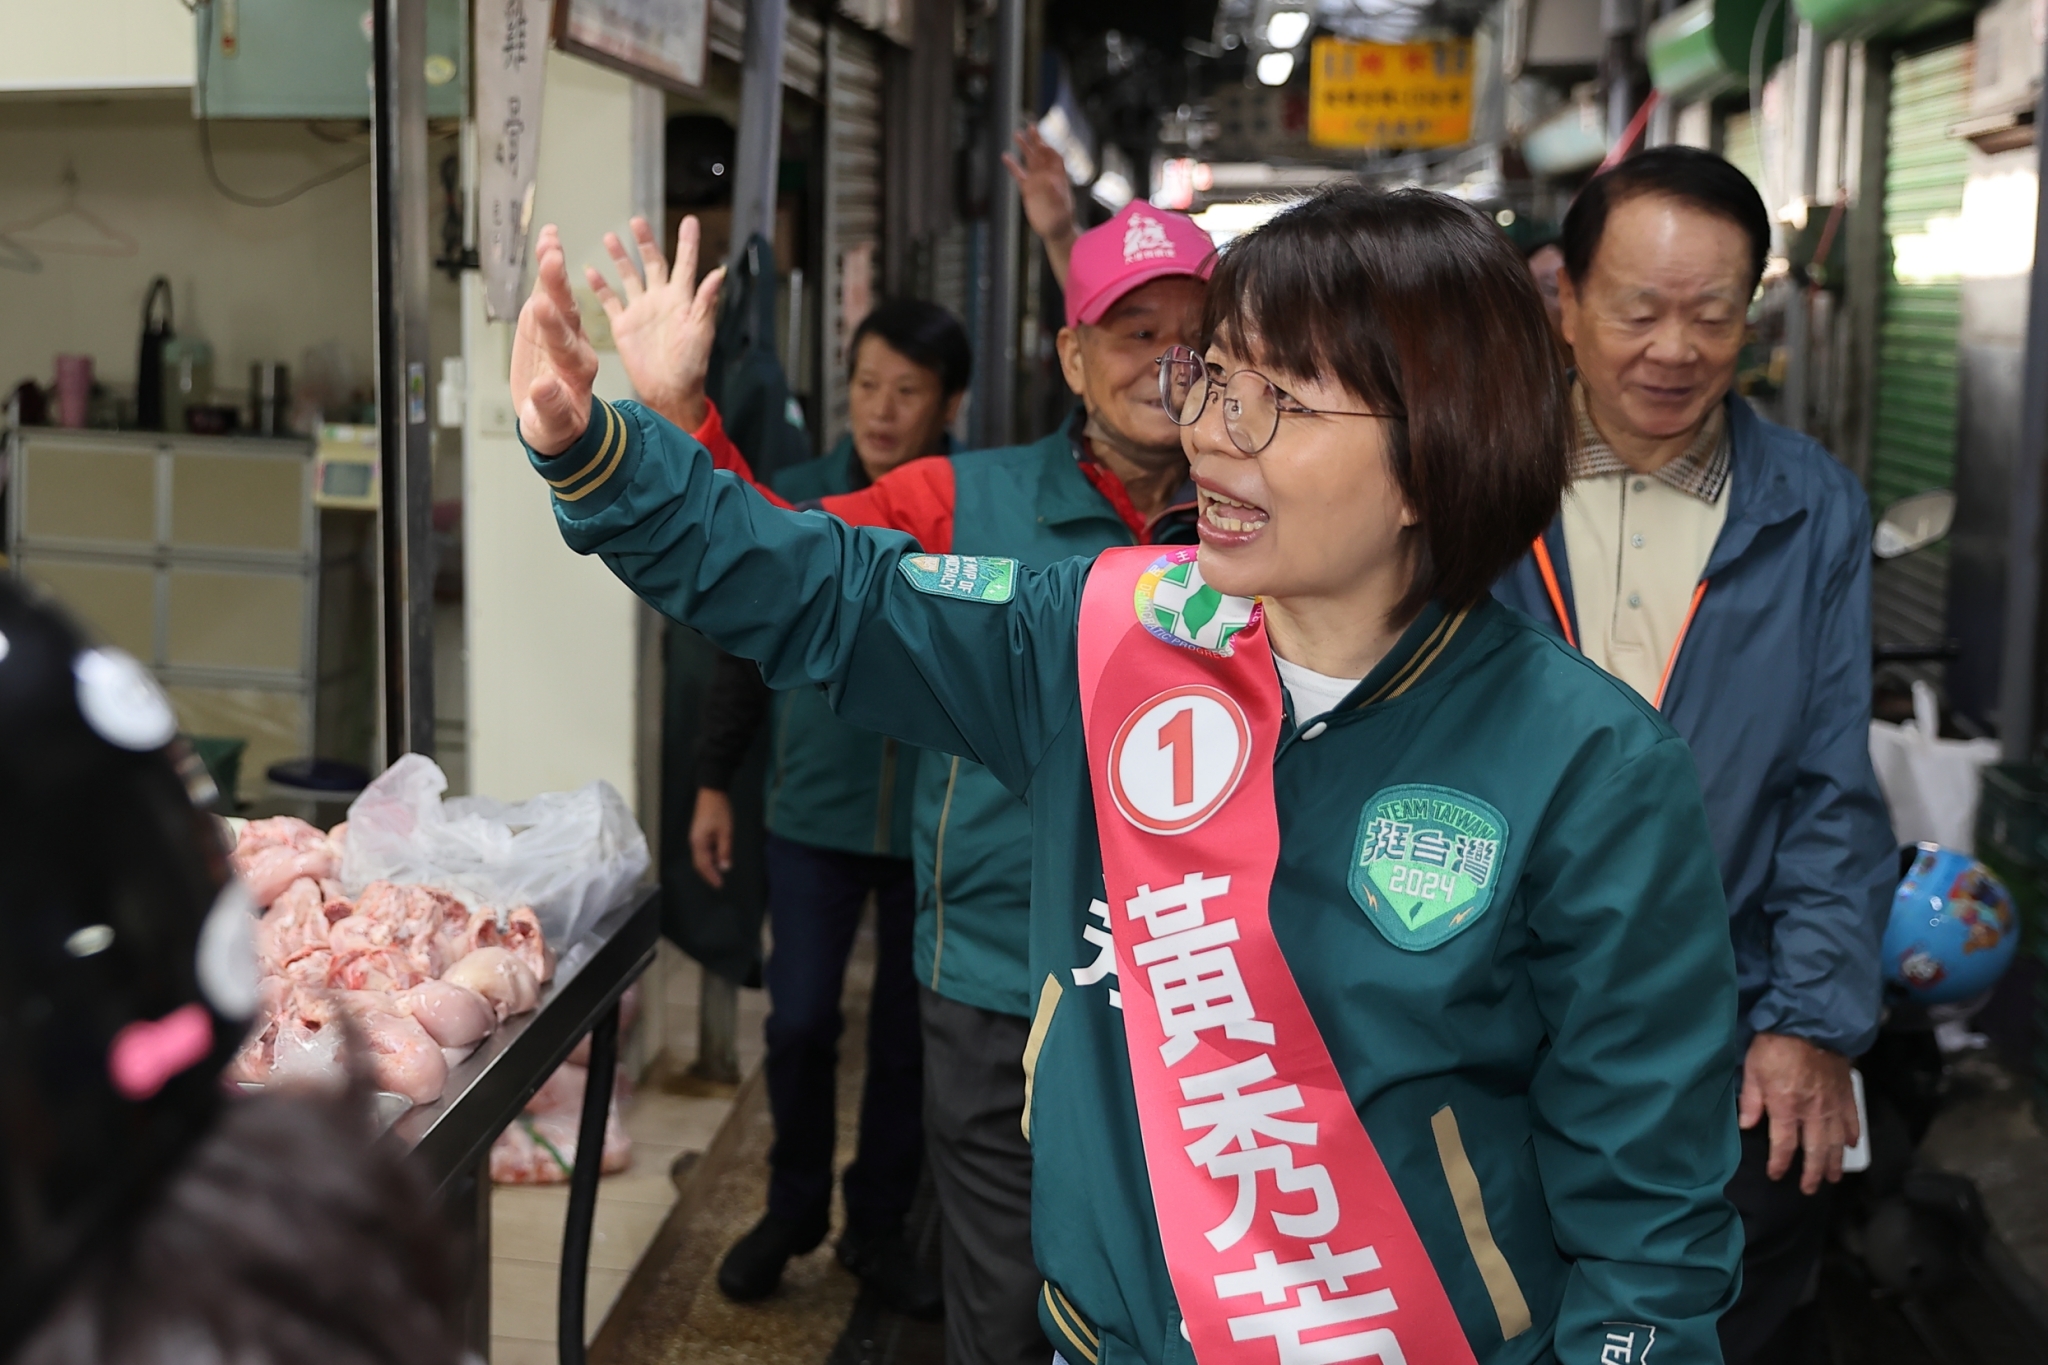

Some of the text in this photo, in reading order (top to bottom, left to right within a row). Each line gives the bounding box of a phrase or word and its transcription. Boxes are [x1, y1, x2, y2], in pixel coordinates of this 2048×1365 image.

[957, 580, 975, 594] OF
[962, 562, 978, 580] MVP
[1138, 583, 1172, 640] DEMOCRATIC
[1158, 707, 1194, 807] 1
[1378, 798, 1497, 840] TEAM TAIWAN
[1359, 817, 1500, 889] 挺台灣
[1388, 864, 1457, 903] 2024
[1125, 871, 1408, 1365] 黃秀芳
